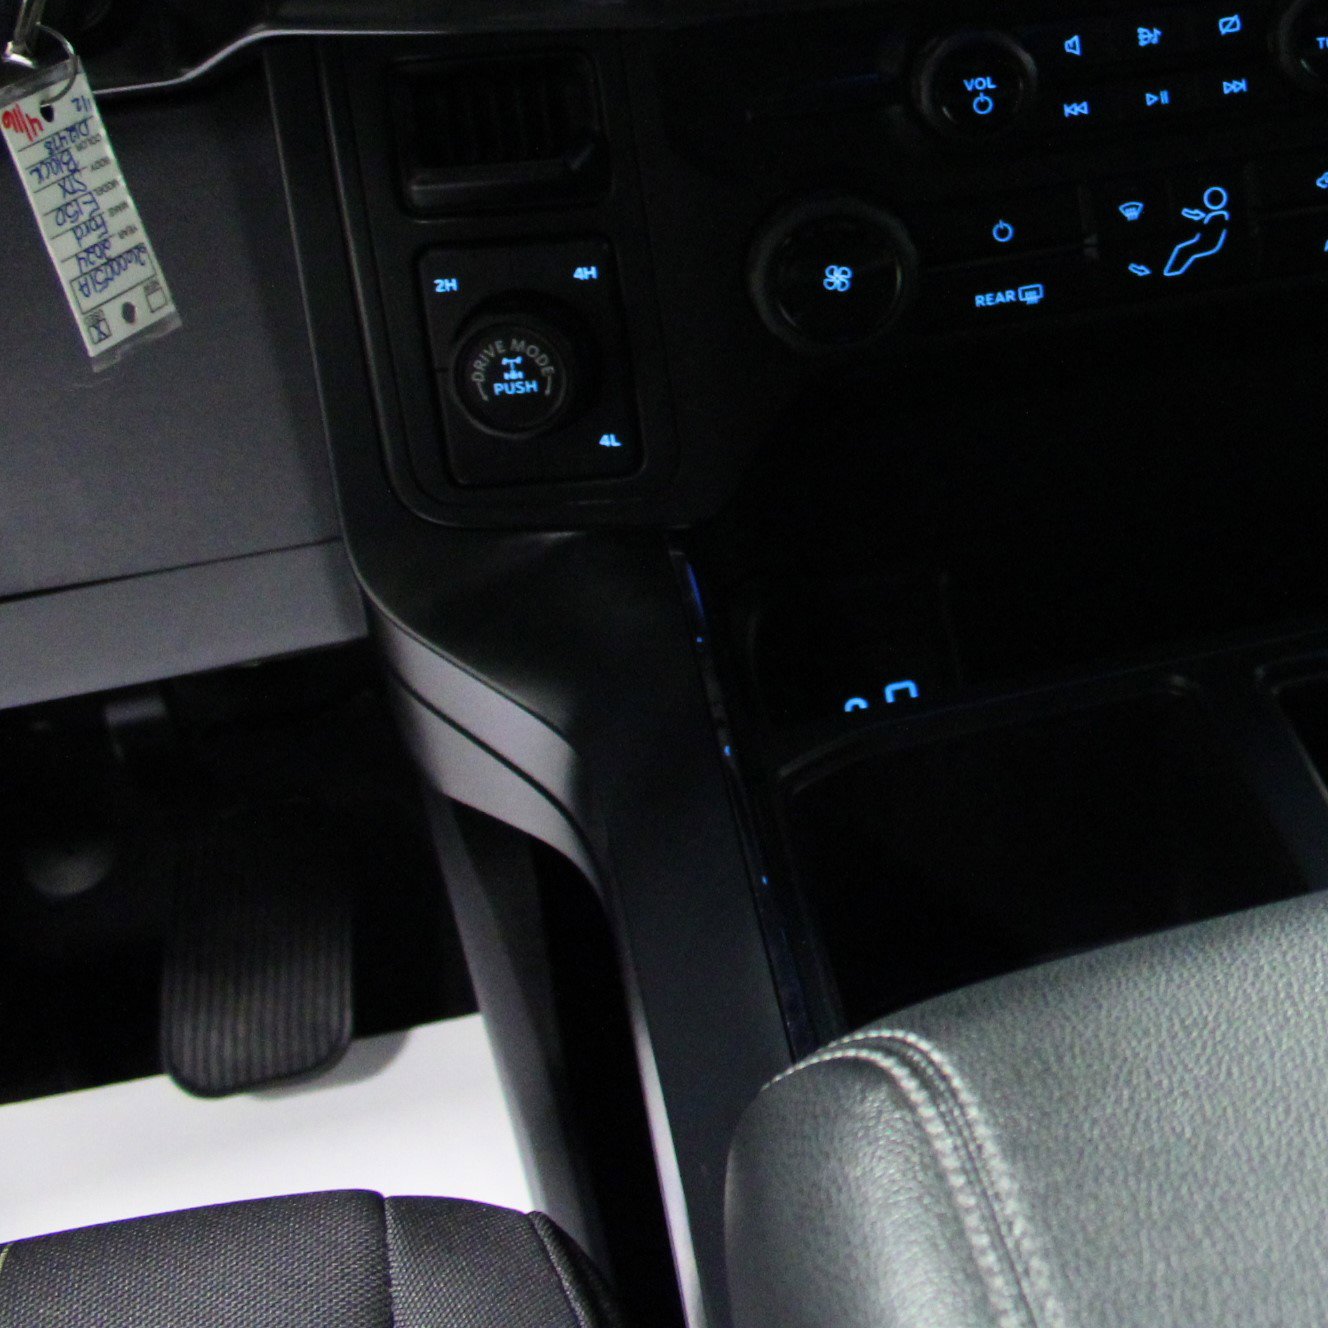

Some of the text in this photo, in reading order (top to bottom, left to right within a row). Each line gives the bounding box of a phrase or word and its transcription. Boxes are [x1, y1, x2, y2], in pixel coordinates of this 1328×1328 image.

[963, 76, 997, 92] VOL
[72, 213, 109, 248] Ford
[573, 265, 598, 281] 4H
[433, 278, 458, 293] 2H
[974, 289, 1017, 307] REAR
[471, 337, 555, 382] DRIVE MODE
[493, 379, 539, 396] PUSH
[599, 433, 622, 447] 4L
